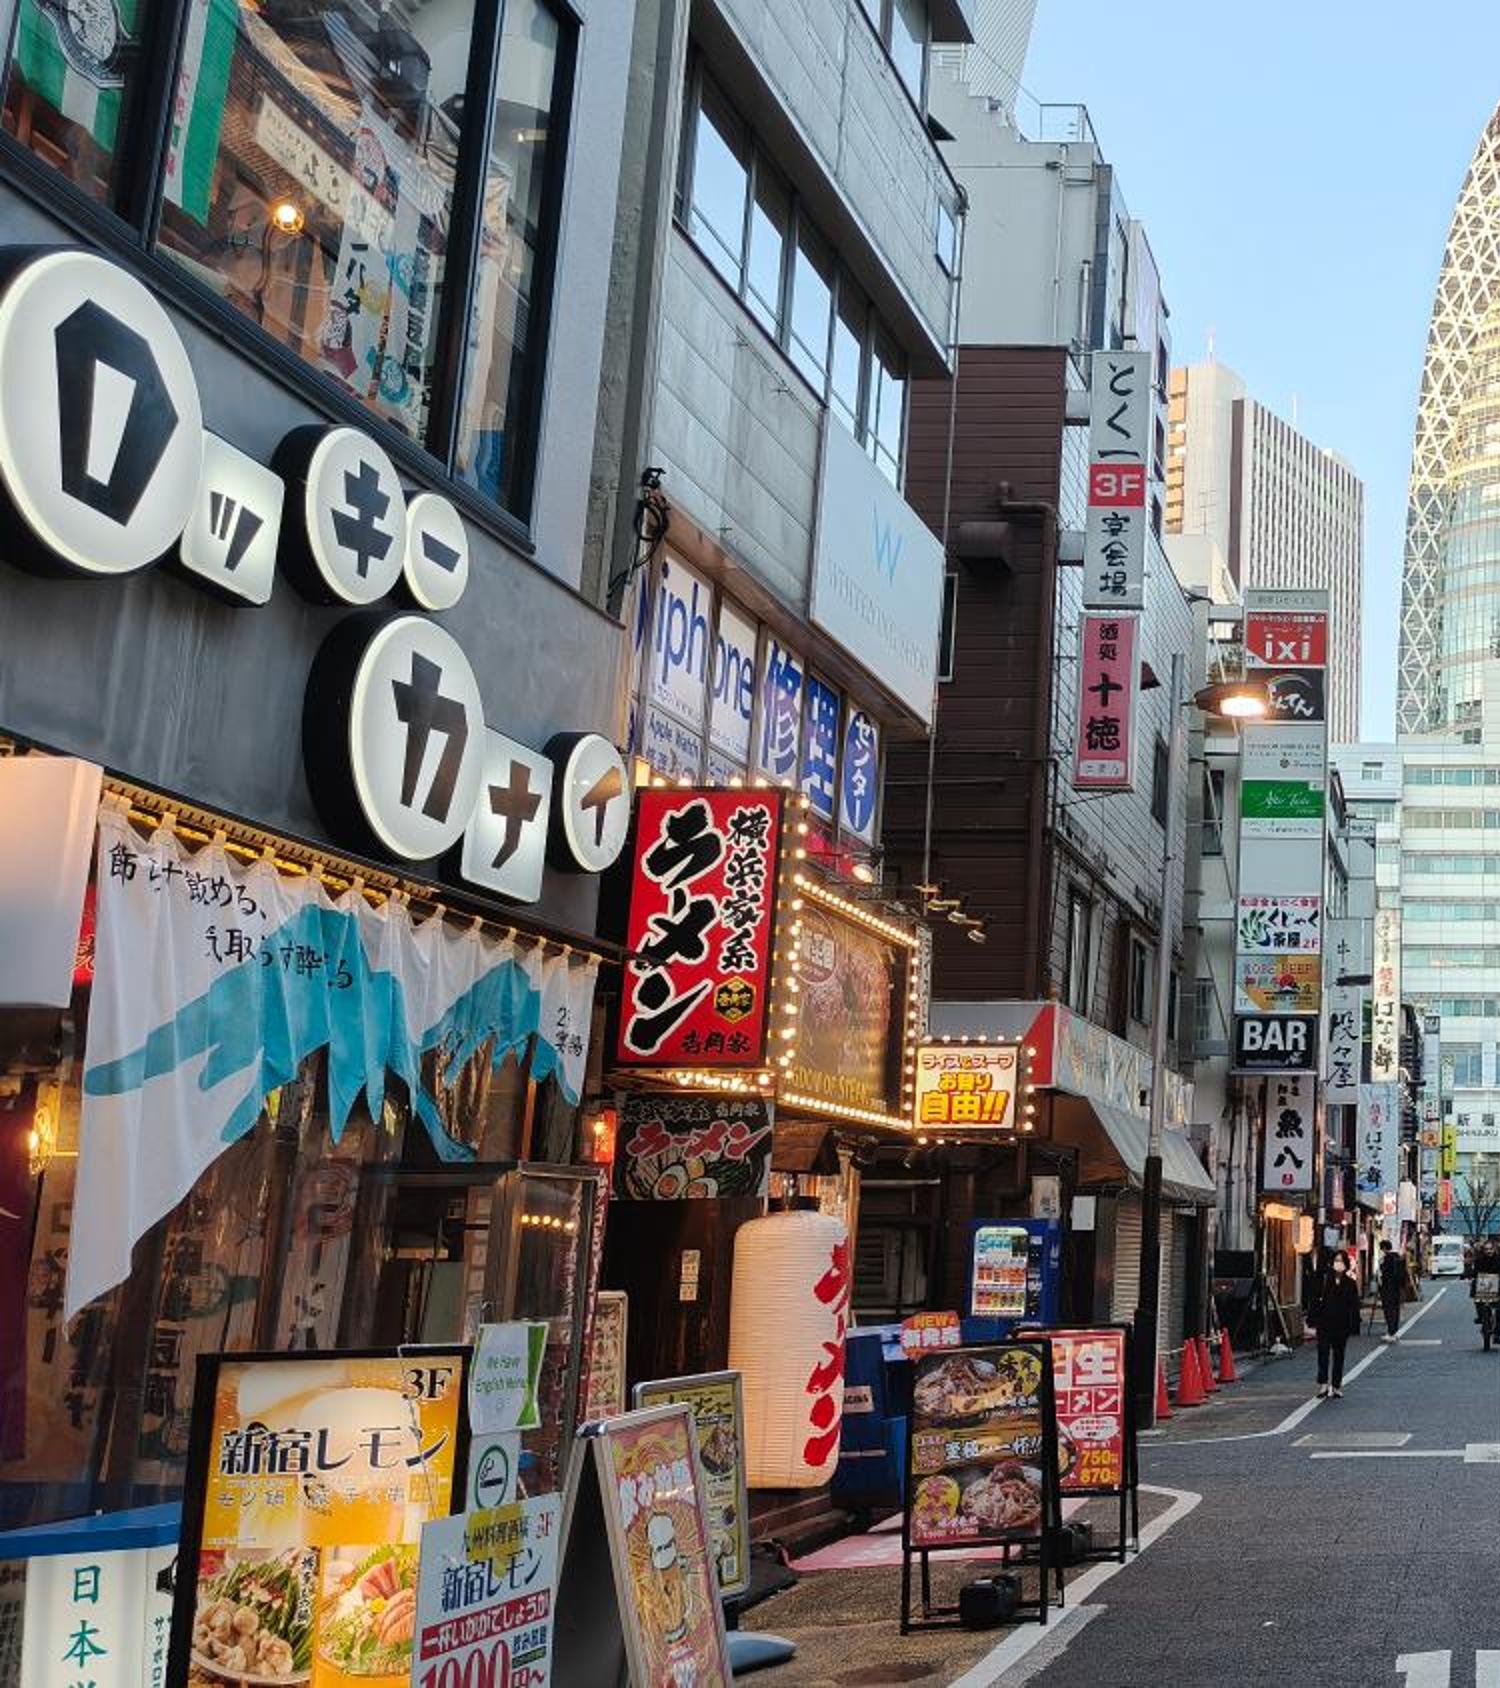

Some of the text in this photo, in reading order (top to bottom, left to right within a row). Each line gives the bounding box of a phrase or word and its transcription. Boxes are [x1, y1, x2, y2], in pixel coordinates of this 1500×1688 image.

[1095, 474, 1142, 497] 3F
[1099, 511, 1132, 597] 宴会場
[1265, 633, 1311, 662] ixi
[716, 803, 772, 975] 横浜家系
[624, 796, 726, 1056] ラーメン
[1242, 1020, 1308, 1051] BAR
[920, 1090, 1010, 1124] 自由!!
[626, 1119, 772, 1160] ラーメン
[401, 1367, 453, 1400] 3F
